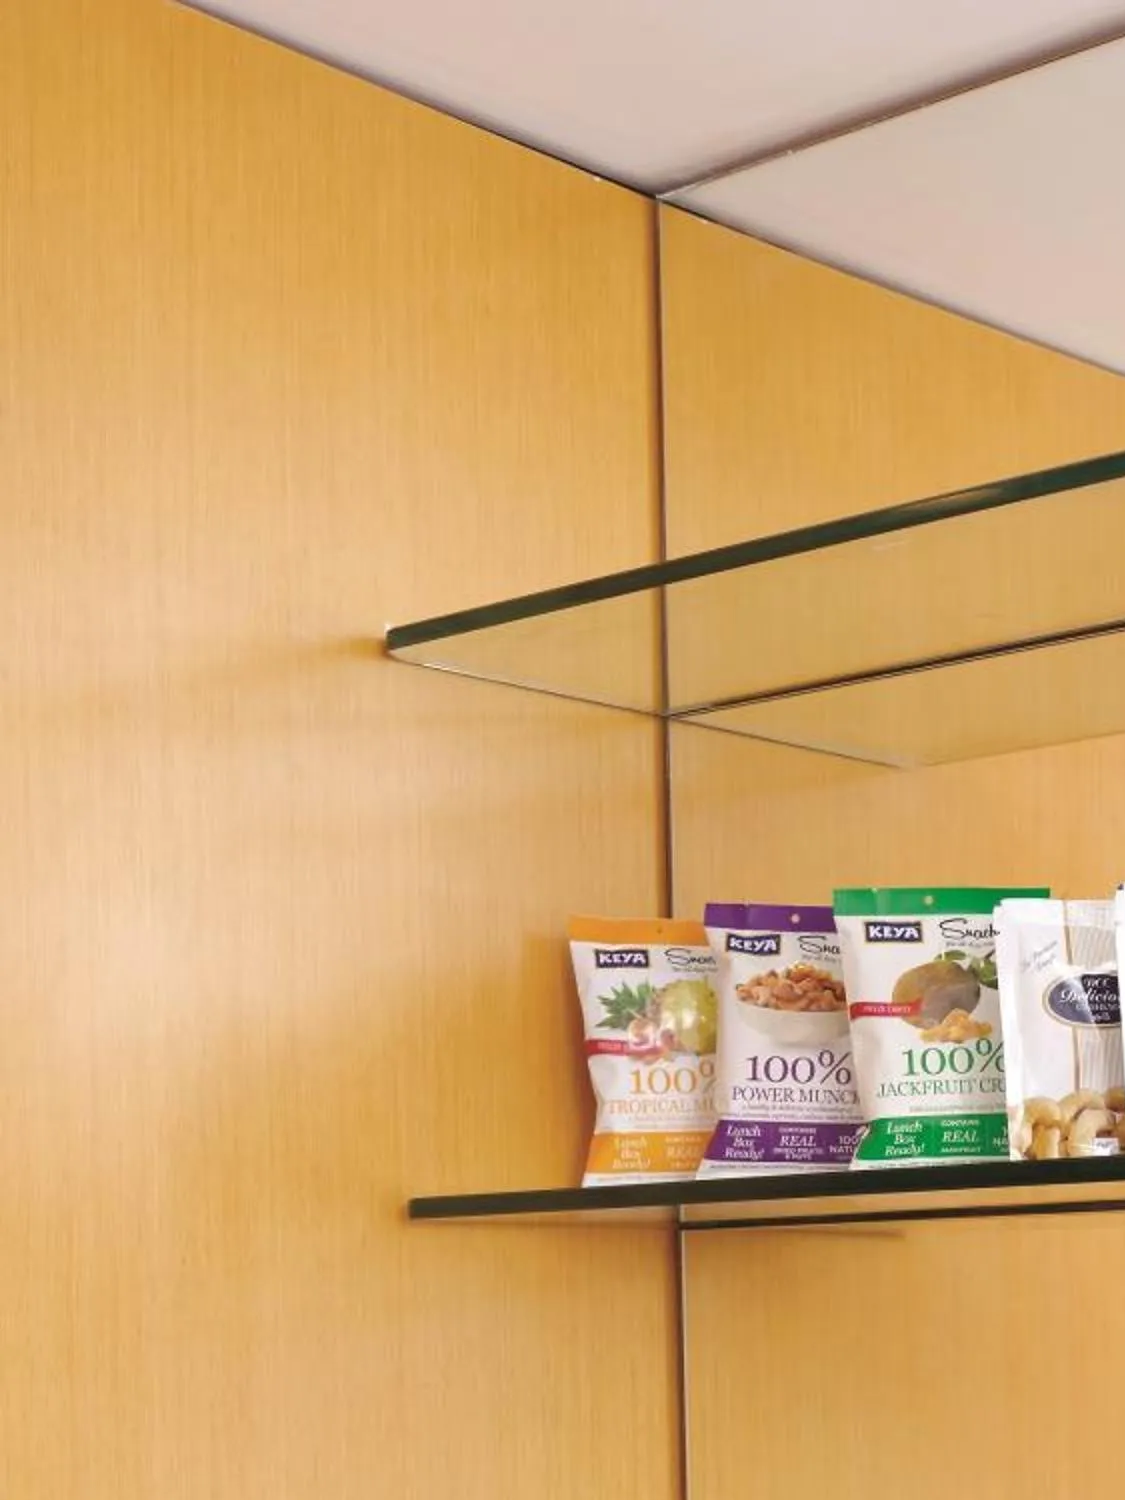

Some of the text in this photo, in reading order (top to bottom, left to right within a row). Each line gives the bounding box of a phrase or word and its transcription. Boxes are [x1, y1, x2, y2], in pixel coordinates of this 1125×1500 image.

[868, 924, 920, 940] KEYA
[729, 936, 778, 952] KEYA
[598, 951, 647, 965] KEYA
[745, 1049, 852, 1085] 100%
[732, 1086, 795, 1103] POWER
[876, 1079, 973, 1098] JACKFRUIT
[779, 1135, 817, 1147] REAL
[942, 1131, 978, 1143] REAL
